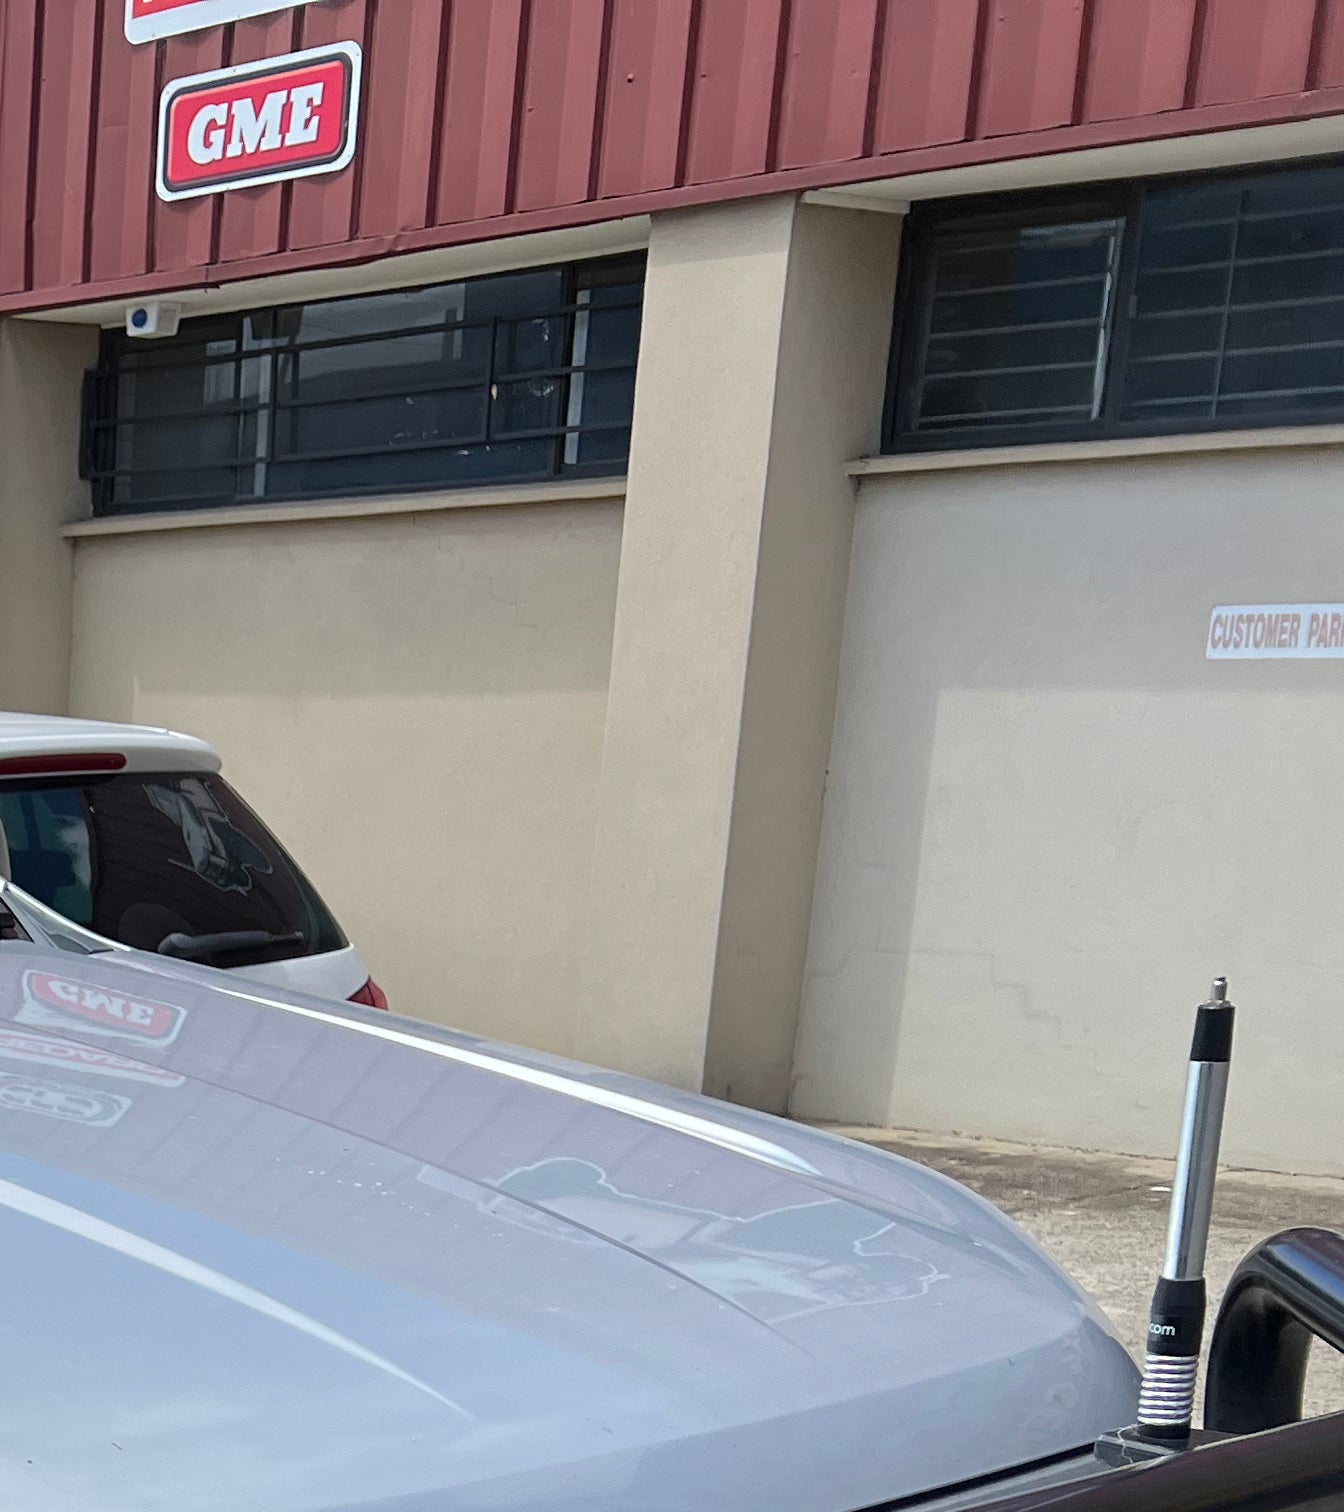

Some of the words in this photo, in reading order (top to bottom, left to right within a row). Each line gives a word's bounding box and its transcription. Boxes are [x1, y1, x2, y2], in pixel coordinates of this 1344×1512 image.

[187, 81, 325, 165] GME
[1210, 612, 1302, 650] CUSTOMER
[1306, 612, 1344, 650] PAR
